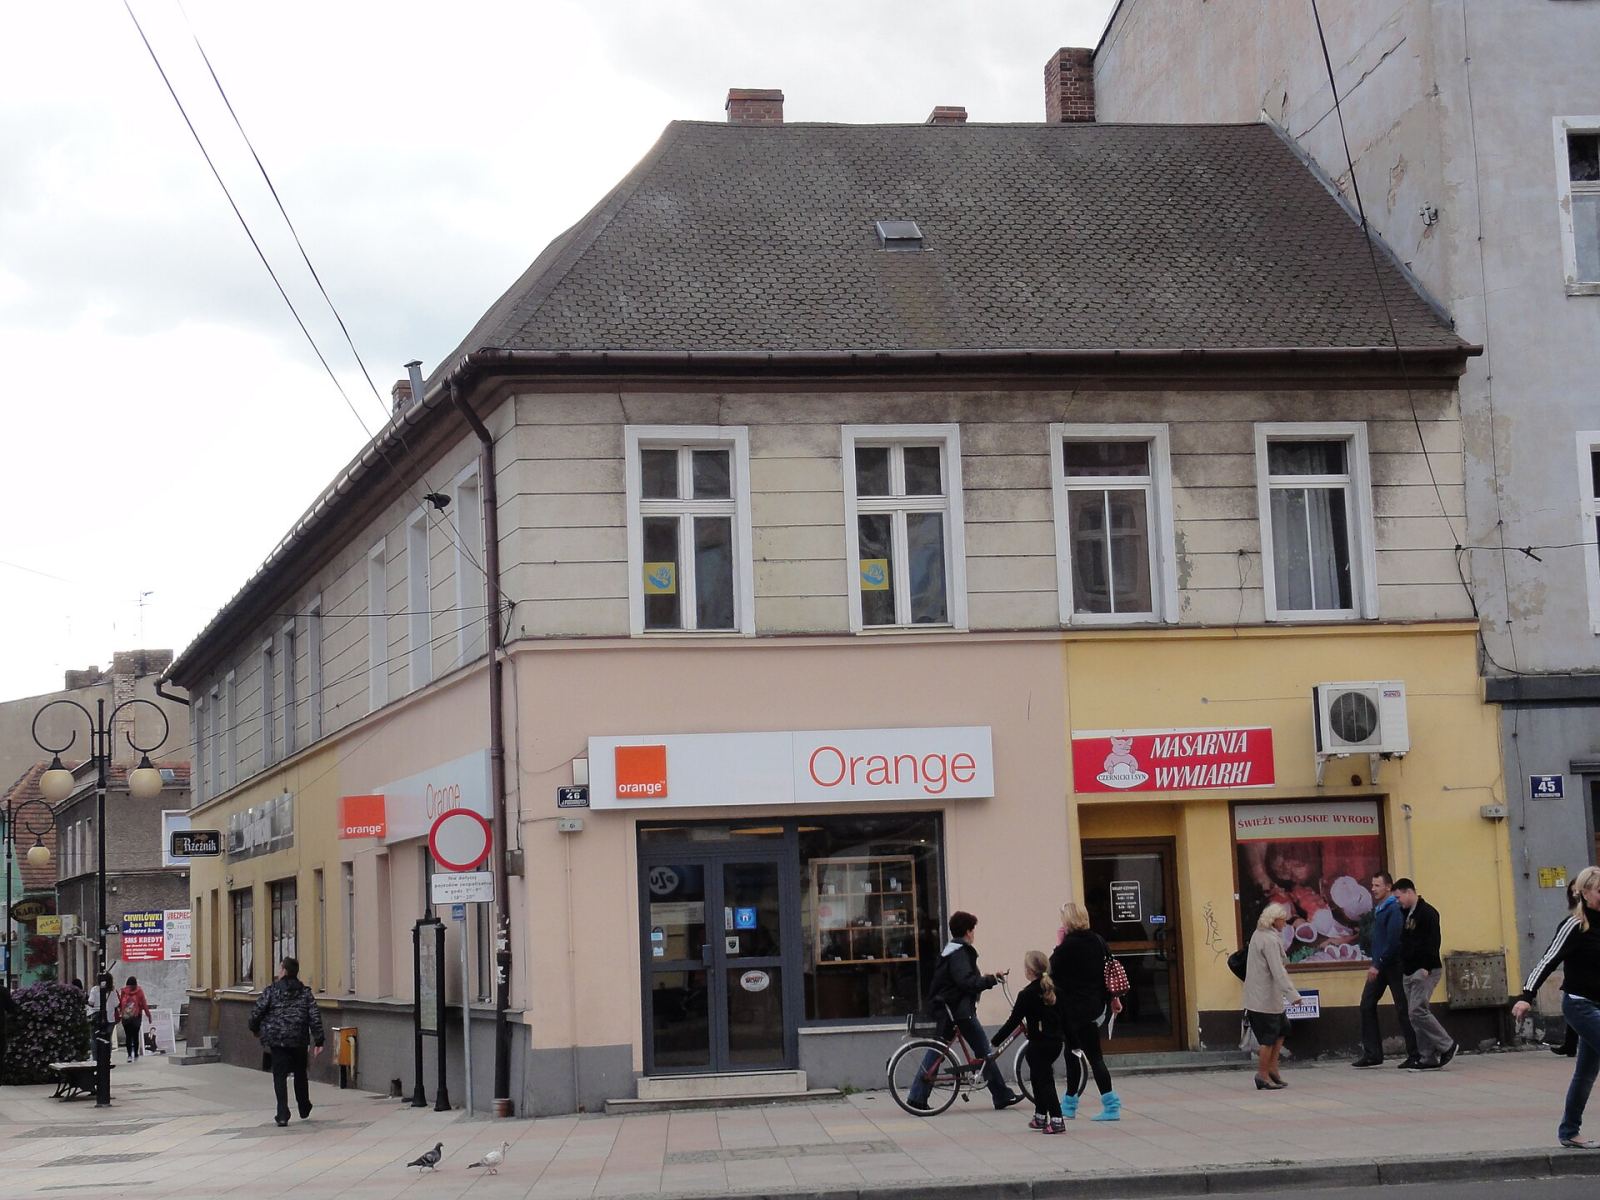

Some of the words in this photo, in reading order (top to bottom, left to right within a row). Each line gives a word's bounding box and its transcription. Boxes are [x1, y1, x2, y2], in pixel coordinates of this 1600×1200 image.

[1150, 731, 1247, 759] MASARNIA
[809, 746, 976, 794] Orange
[1154, 761, 1251, 788] WYMIARKI
[618, 782, 662, 795] orange
[1538, 781, 1556, 792] 45
[1237, 816, 1275, 829] ŚWIEŻE
[1278, 814, 1328, 824] SWOJSKIE
[1332, 814, 1376, 824] WYROBY
[346, 824, 382, 835] orange
[124, 912, 162, 921] CHWILÓWKI
